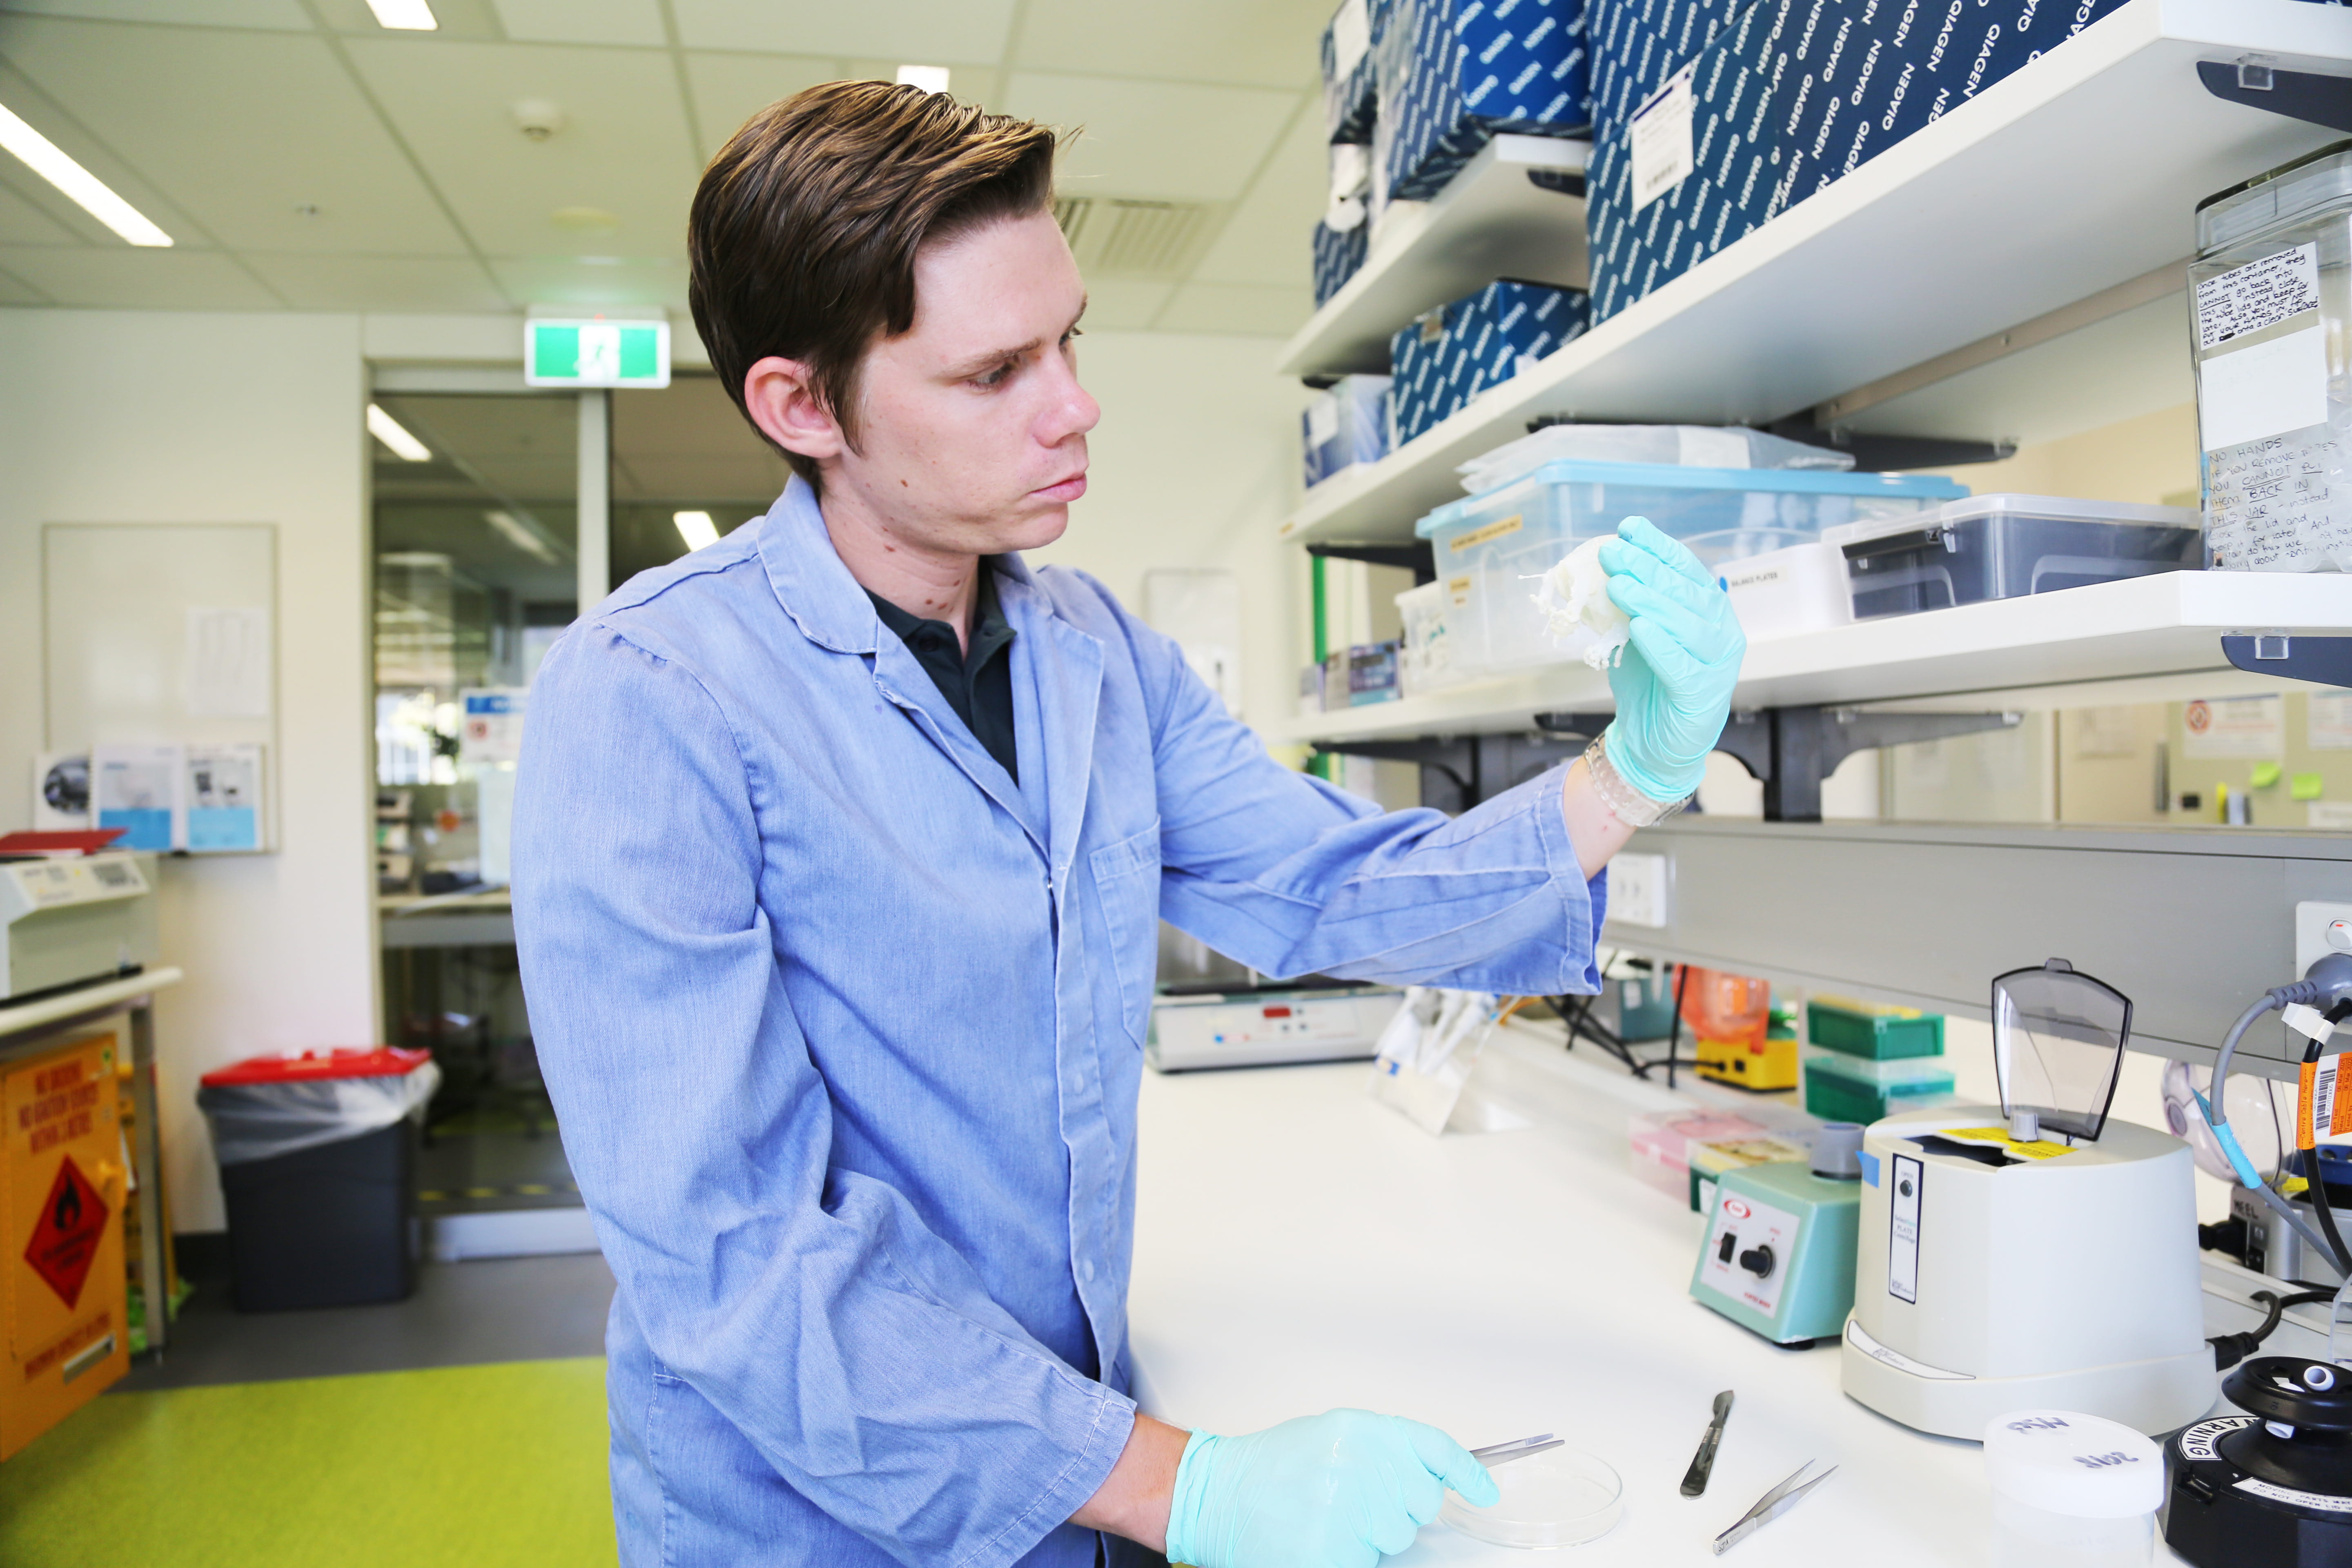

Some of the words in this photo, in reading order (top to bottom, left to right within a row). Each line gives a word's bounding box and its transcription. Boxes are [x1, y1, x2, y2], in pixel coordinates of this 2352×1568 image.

[1927, 0, 1962, 72] QIAGEN
[1823, 17, 1853, 82] QIAGEN
[1851, 39, 1882, 105] QIAGEN
[1963, 24, 2000, 98] QIAGEN
[1882, 62, 1915, 130] QIAGEN
[1812, 97, 1840, 160] QIAGEN
[2221, 270, 2241, 281] tubes
[2245, 264, 2257, 273] are
[2261, 248, 2296, 266] removed
[2198, 289, 2216, 299] from
[2223, 281, 2238, 290] this
[2200, 293, 2231, 308] CANNOT
[2236, 287, 2246, 298] go
[2250, 278, 2271, 289] back
[2275, 269, 2293, 280] into
[2278, 276, 2301, 289] close
[2216, 310, 2233, 319] tube
[2255, 296, 2269, 306] and
[2274, 288, 2295, 298] keep
[2297, 282, 2309, 292] for
[2264, 313, 2285, 326] clean
[2209, 452, 2226, 463] NO
[2237, 438, 2283, 459] HANDS
[2209, 482, 2229, 494] YOU
[2242, 465, 2291, 486] CANNOT
[2227, 463, 2247, 475] YOU
[2250, 482, 2283, 499] BACK
[2294, 479, 2309, 490] IN
[2245, 505, 2269, 518] JAR
[2266, 517, 2279, 528] lid
[2287, 513, 2307, 526] and
[2252, 535, 2266, 546] for
[2311, 516, 2330, 530] And
[2247, 548, 2258, 556] do
[2285, 539, 2303, 548] we
[2254, 553, 2278, 565] about
[2072, 1451, 2139, 1469] 2018
[2258, 1483, 2294, 1495] MOVING
[2300, 1495, 2328, 1503] PARTS
[2295, 1498, 2320, 1507] OPEN
